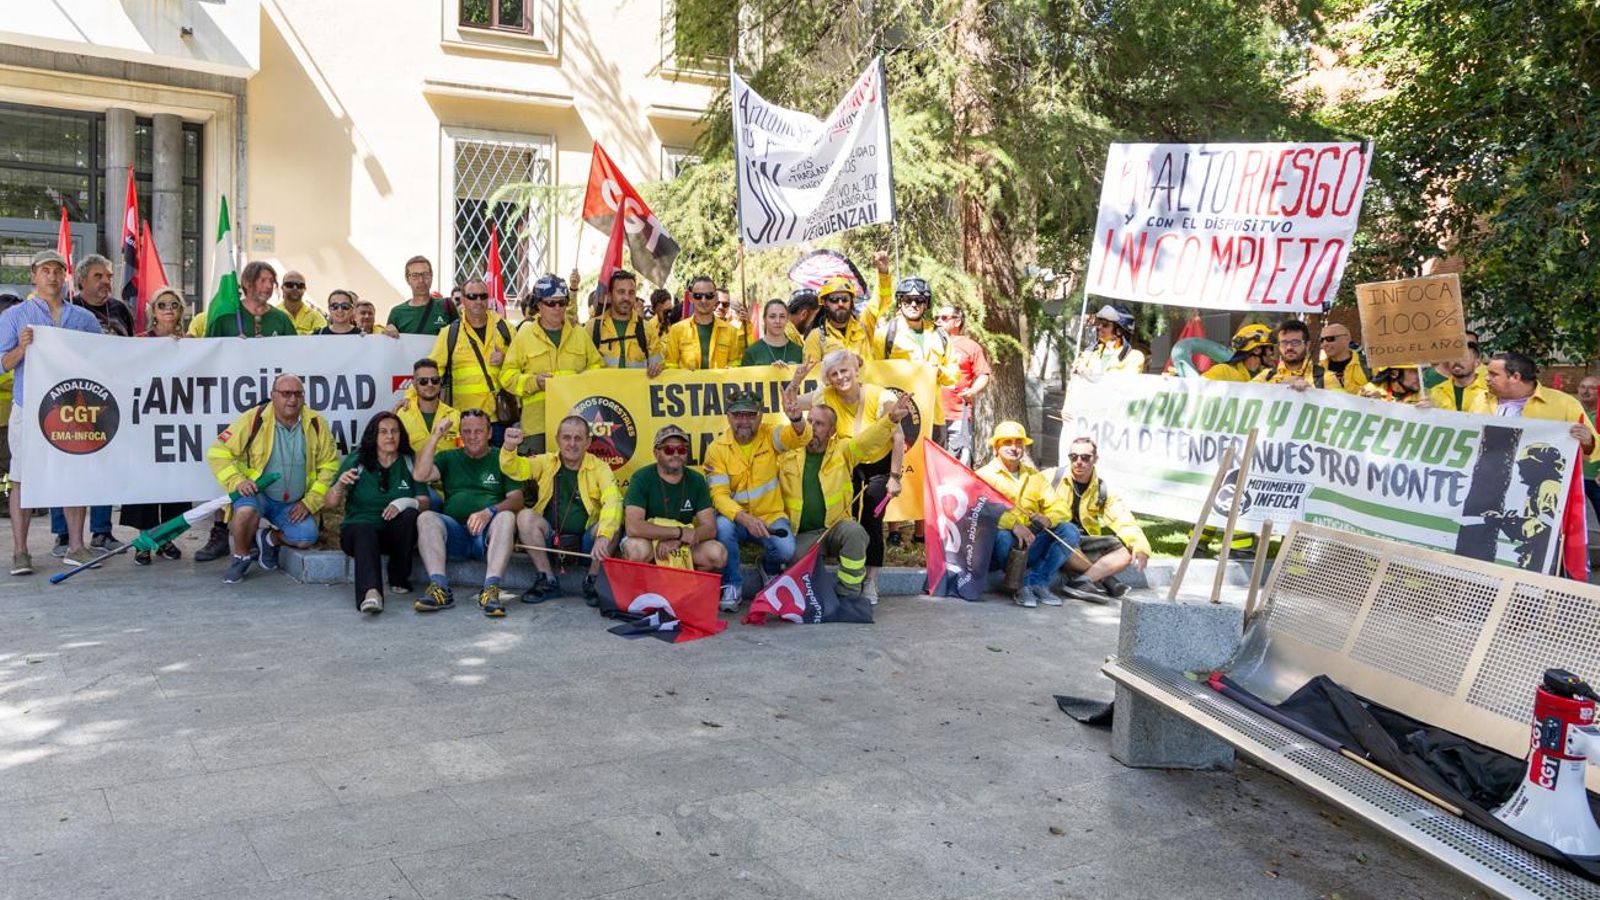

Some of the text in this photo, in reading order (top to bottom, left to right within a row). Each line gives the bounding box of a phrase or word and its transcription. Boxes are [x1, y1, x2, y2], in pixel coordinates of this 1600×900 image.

[1148, 150, 1236, 215] ALTO
[1147, 216, 1174, 229] CON
[1182, 217, 1197, 229] EL
[1367, 282, 1453, 306] INFOCA
[1374, 309, 1458, 336] 100%
[1369, 345, 1405, 356] TODO
[1409, 343, 1424, 352] EL
[60, 405, 100, 423] CGT
[51, 431, 107, 441] EMA-INFOCA
[154, 424, 203, 463] EN
[1267, 400, 1293, 438] Y
[1291, 402, 1480, 469] DERECHOS
[1251, 440, 1360, 487] NUESTRO
[1366, 461, 1469, 507] MONTE
[1247, 479, 1306, 494] MOVIMIENTO
[1253, 492, 1300, 509] INFOCA
[1538, 755, 1560, 789] CGT
